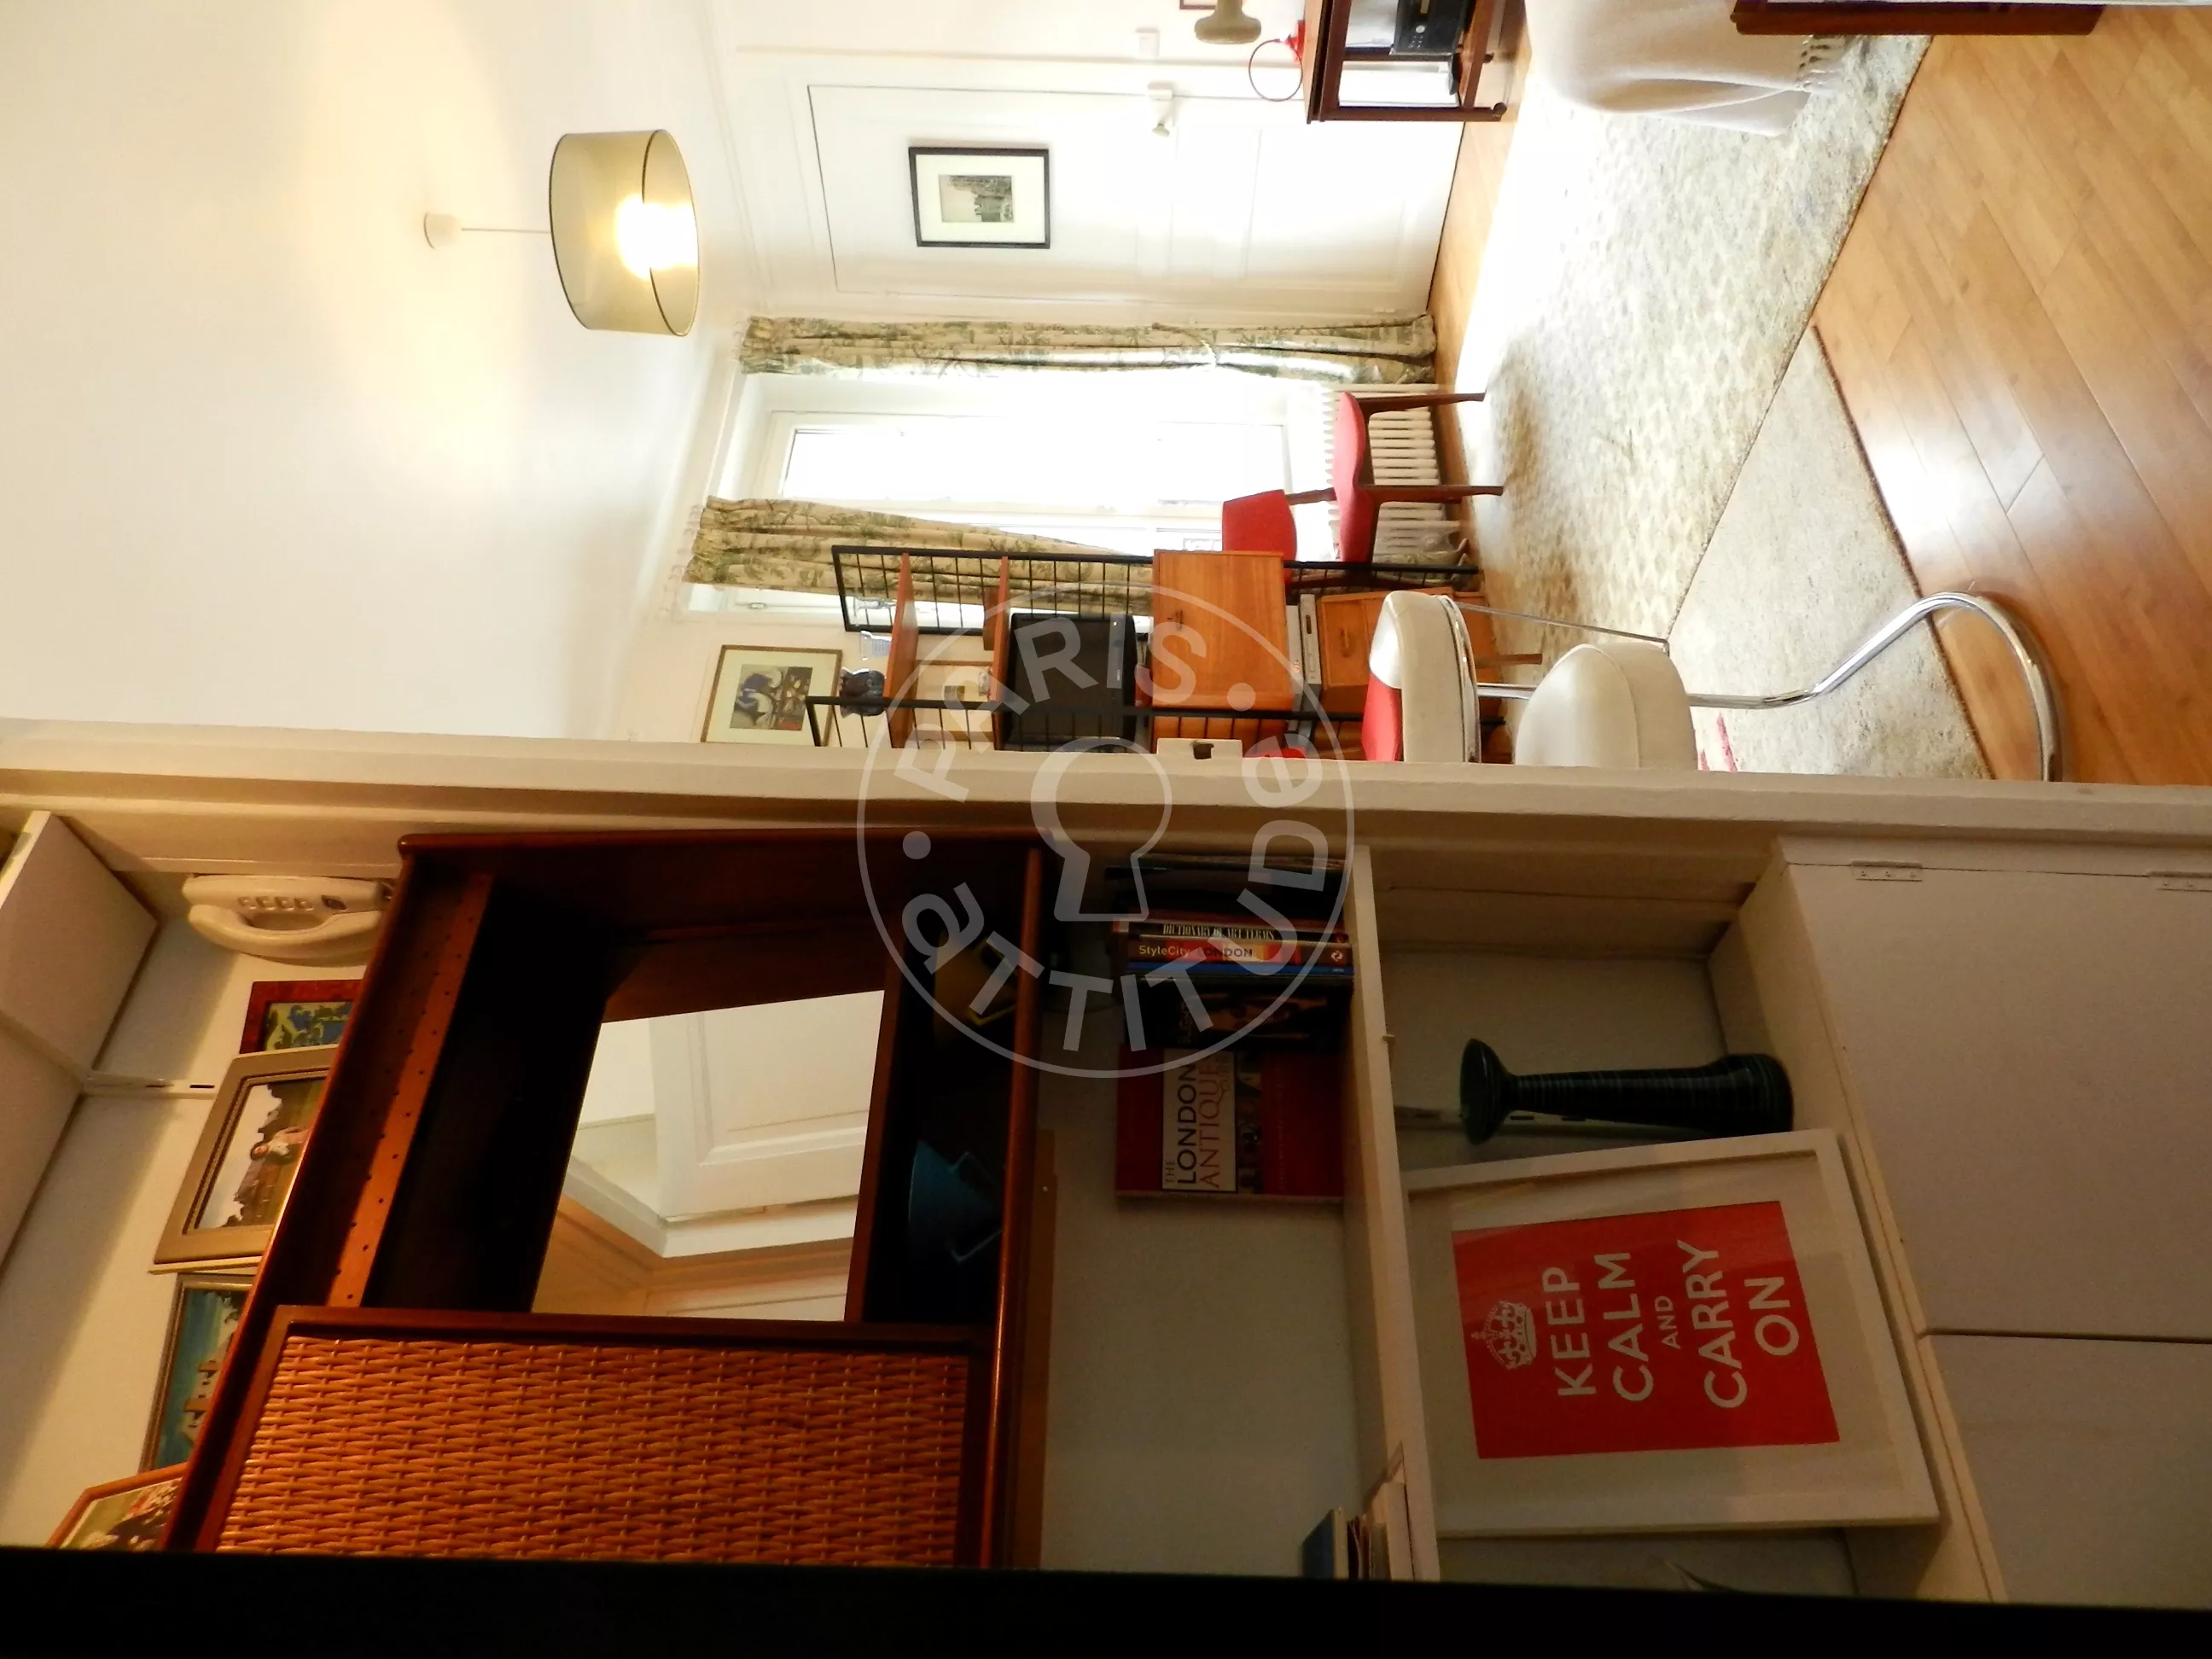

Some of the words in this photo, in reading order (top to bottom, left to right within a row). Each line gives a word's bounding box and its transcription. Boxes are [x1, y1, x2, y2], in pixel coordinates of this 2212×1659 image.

[1138, 945, 1190, 958] StyleCity
[1197, 947, 1253, 958] LONDON
[1162, 923, 1211, 937] DICTIONARY
[1226, 927, 1243, 939] ART
[1245, 928, 1275, 940] TERMS
[1177, 1063, 1196, 1185] LONDON
[1165, 1160, 1175, 1184] THE
[1542, 1266, 1597, 1396] KEEP
[1593, 1252, 1653, 1401] CALM
[1654, 1295, 1681, 1349] AND
[1677, 1239, 1748, 1408] CARRY
[1744, 1277, 1800, 1356] ON
